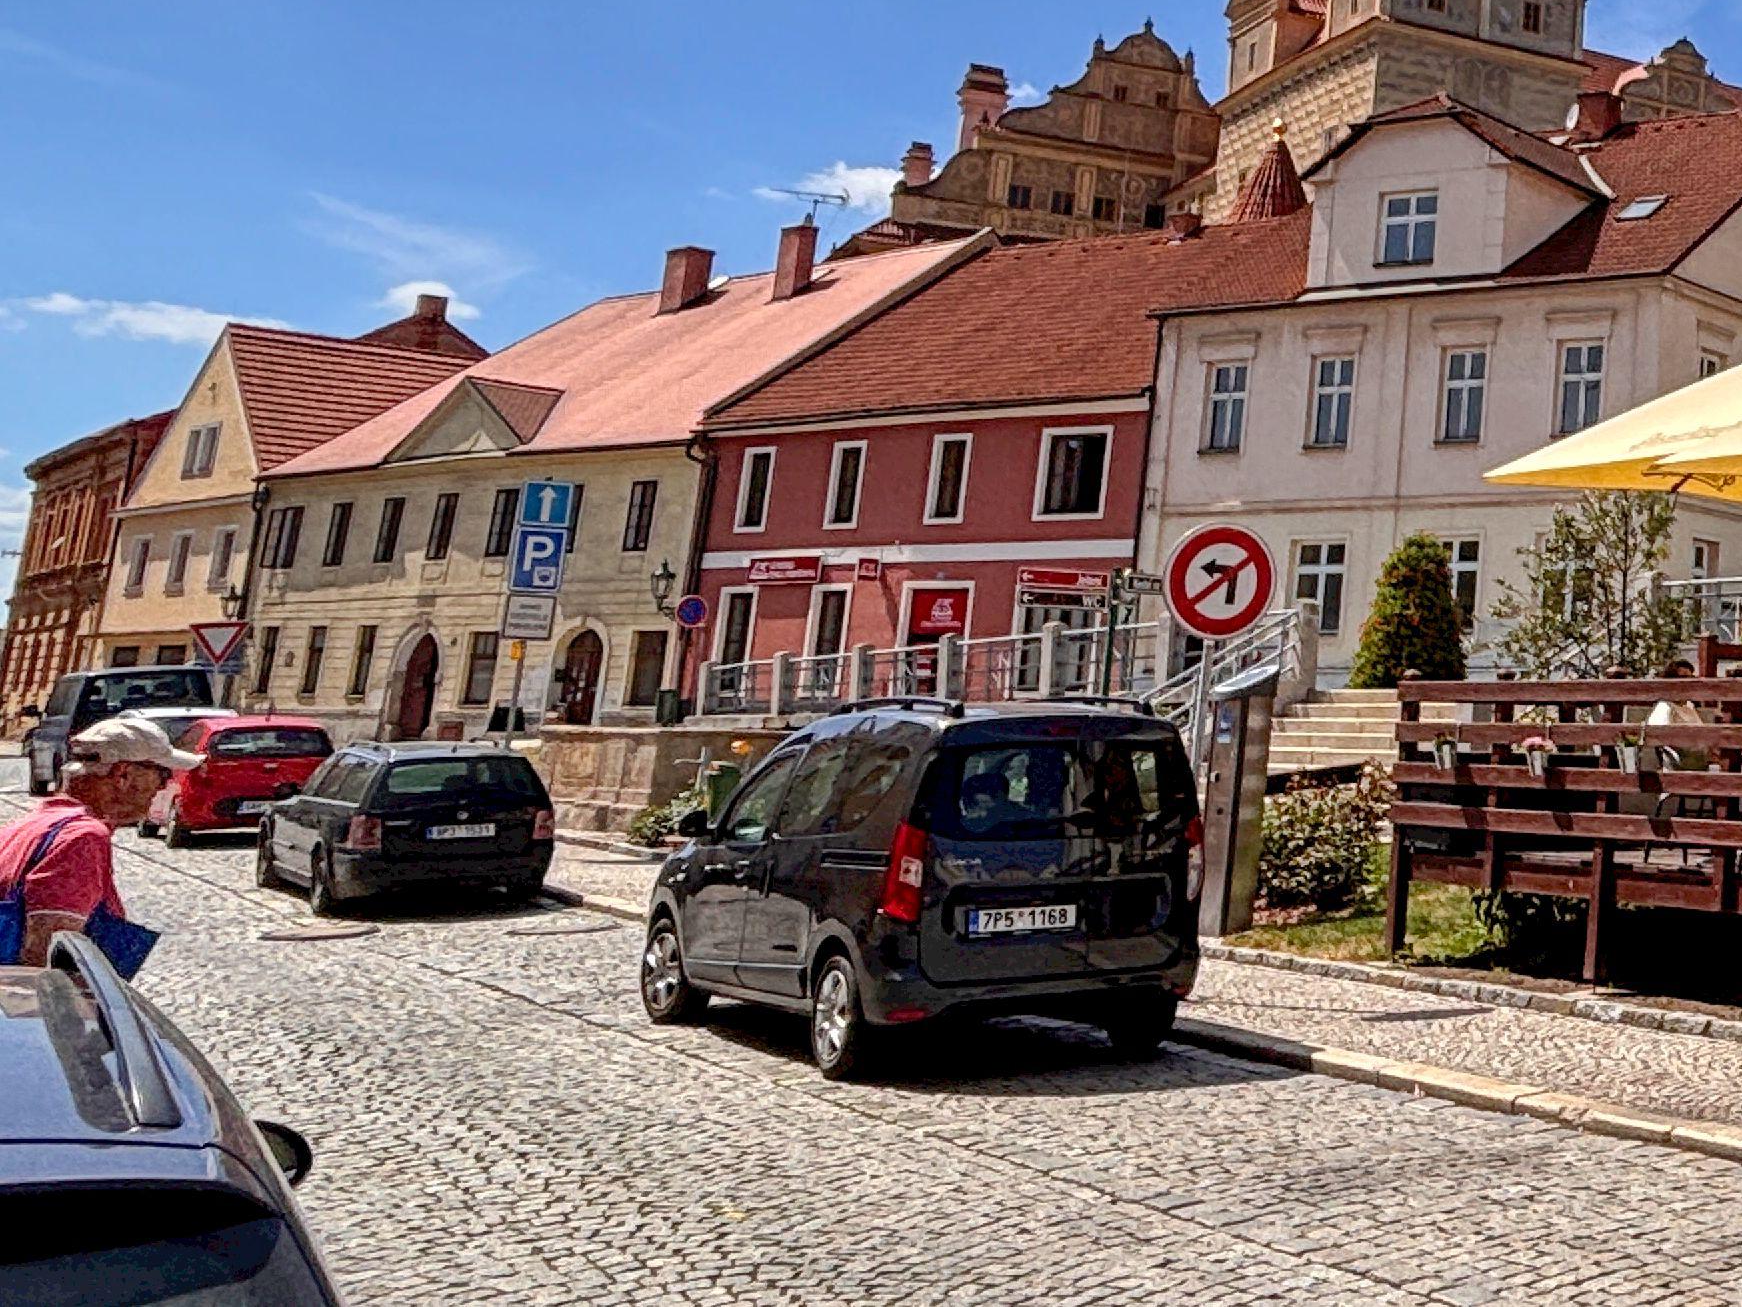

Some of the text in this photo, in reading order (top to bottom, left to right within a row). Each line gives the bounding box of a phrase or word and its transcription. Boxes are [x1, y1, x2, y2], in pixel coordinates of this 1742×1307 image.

[522, 535, 555, 572] P
[982, 907, 1068, 930] 7P5 1168
